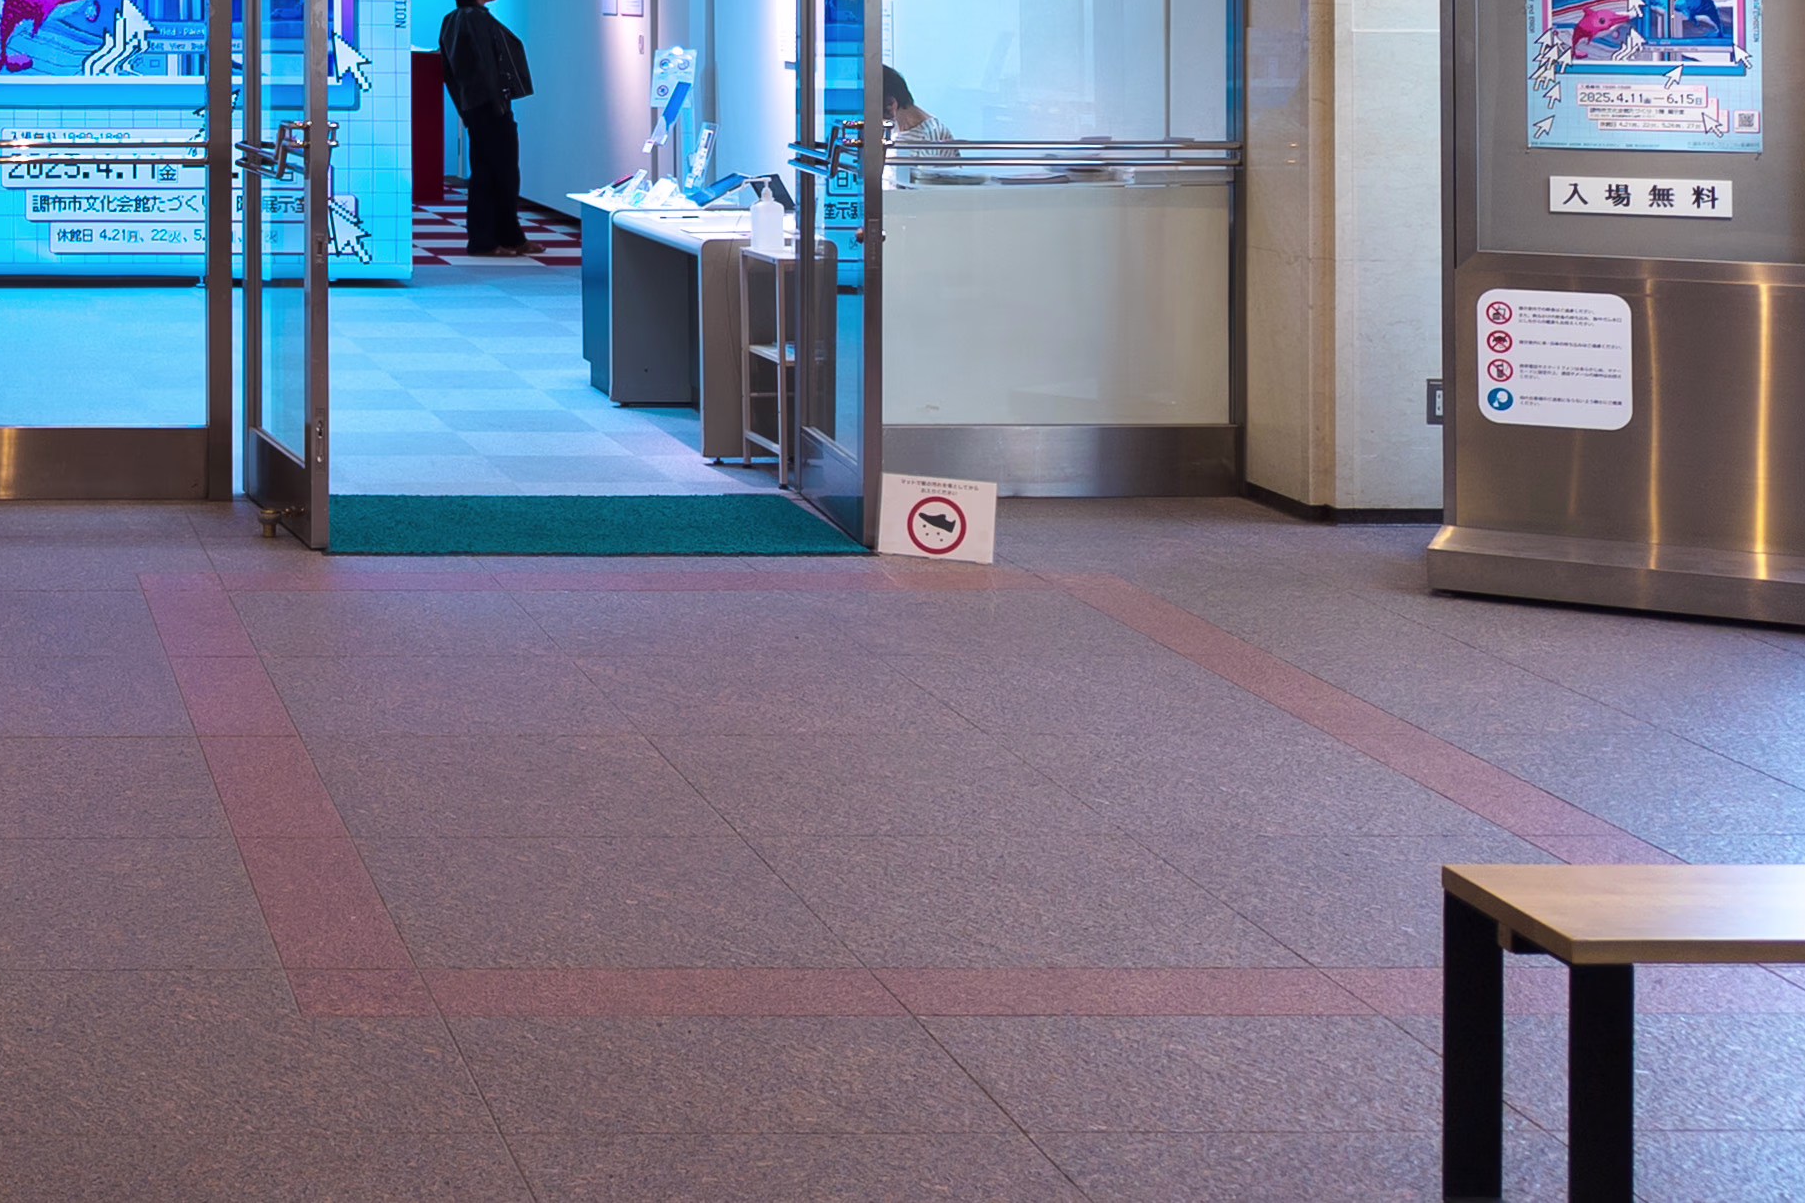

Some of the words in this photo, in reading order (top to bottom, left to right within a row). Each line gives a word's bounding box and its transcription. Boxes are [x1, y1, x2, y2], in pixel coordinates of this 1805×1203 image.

[32, 195, 206, 213] 調布市文化会館たづく
[1562, 183, 1719, 209] 入場無料
[57, 228, 94, 243] 休館日
